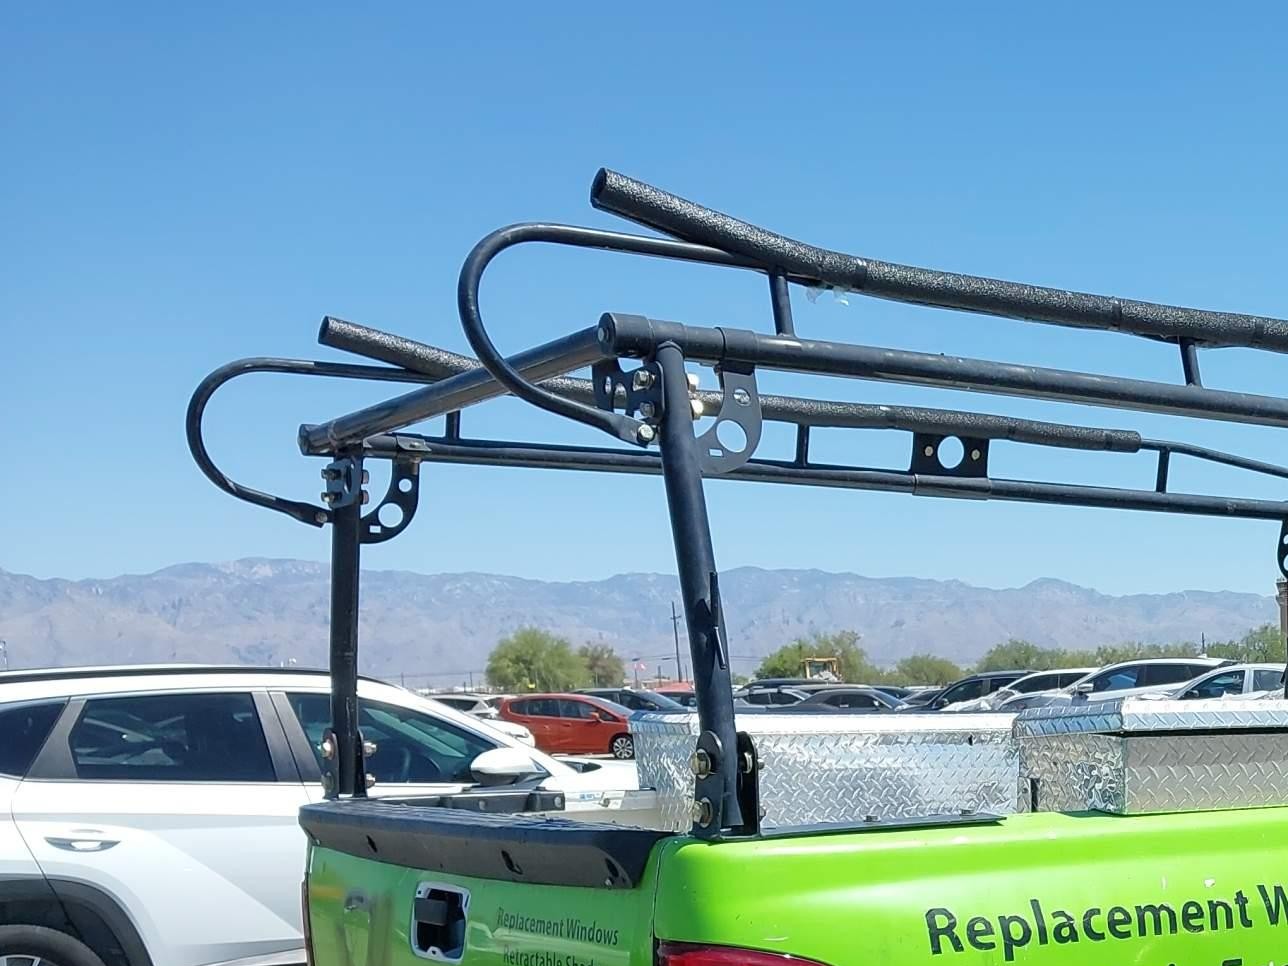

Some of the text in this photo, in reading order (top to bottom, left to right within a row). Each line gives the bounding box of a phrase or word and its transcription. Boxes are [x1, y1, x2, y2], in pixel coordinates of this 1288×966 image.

[496, 907, 619, 945] Replacement Windows
[925, 900, 1249, 961] Replacement
